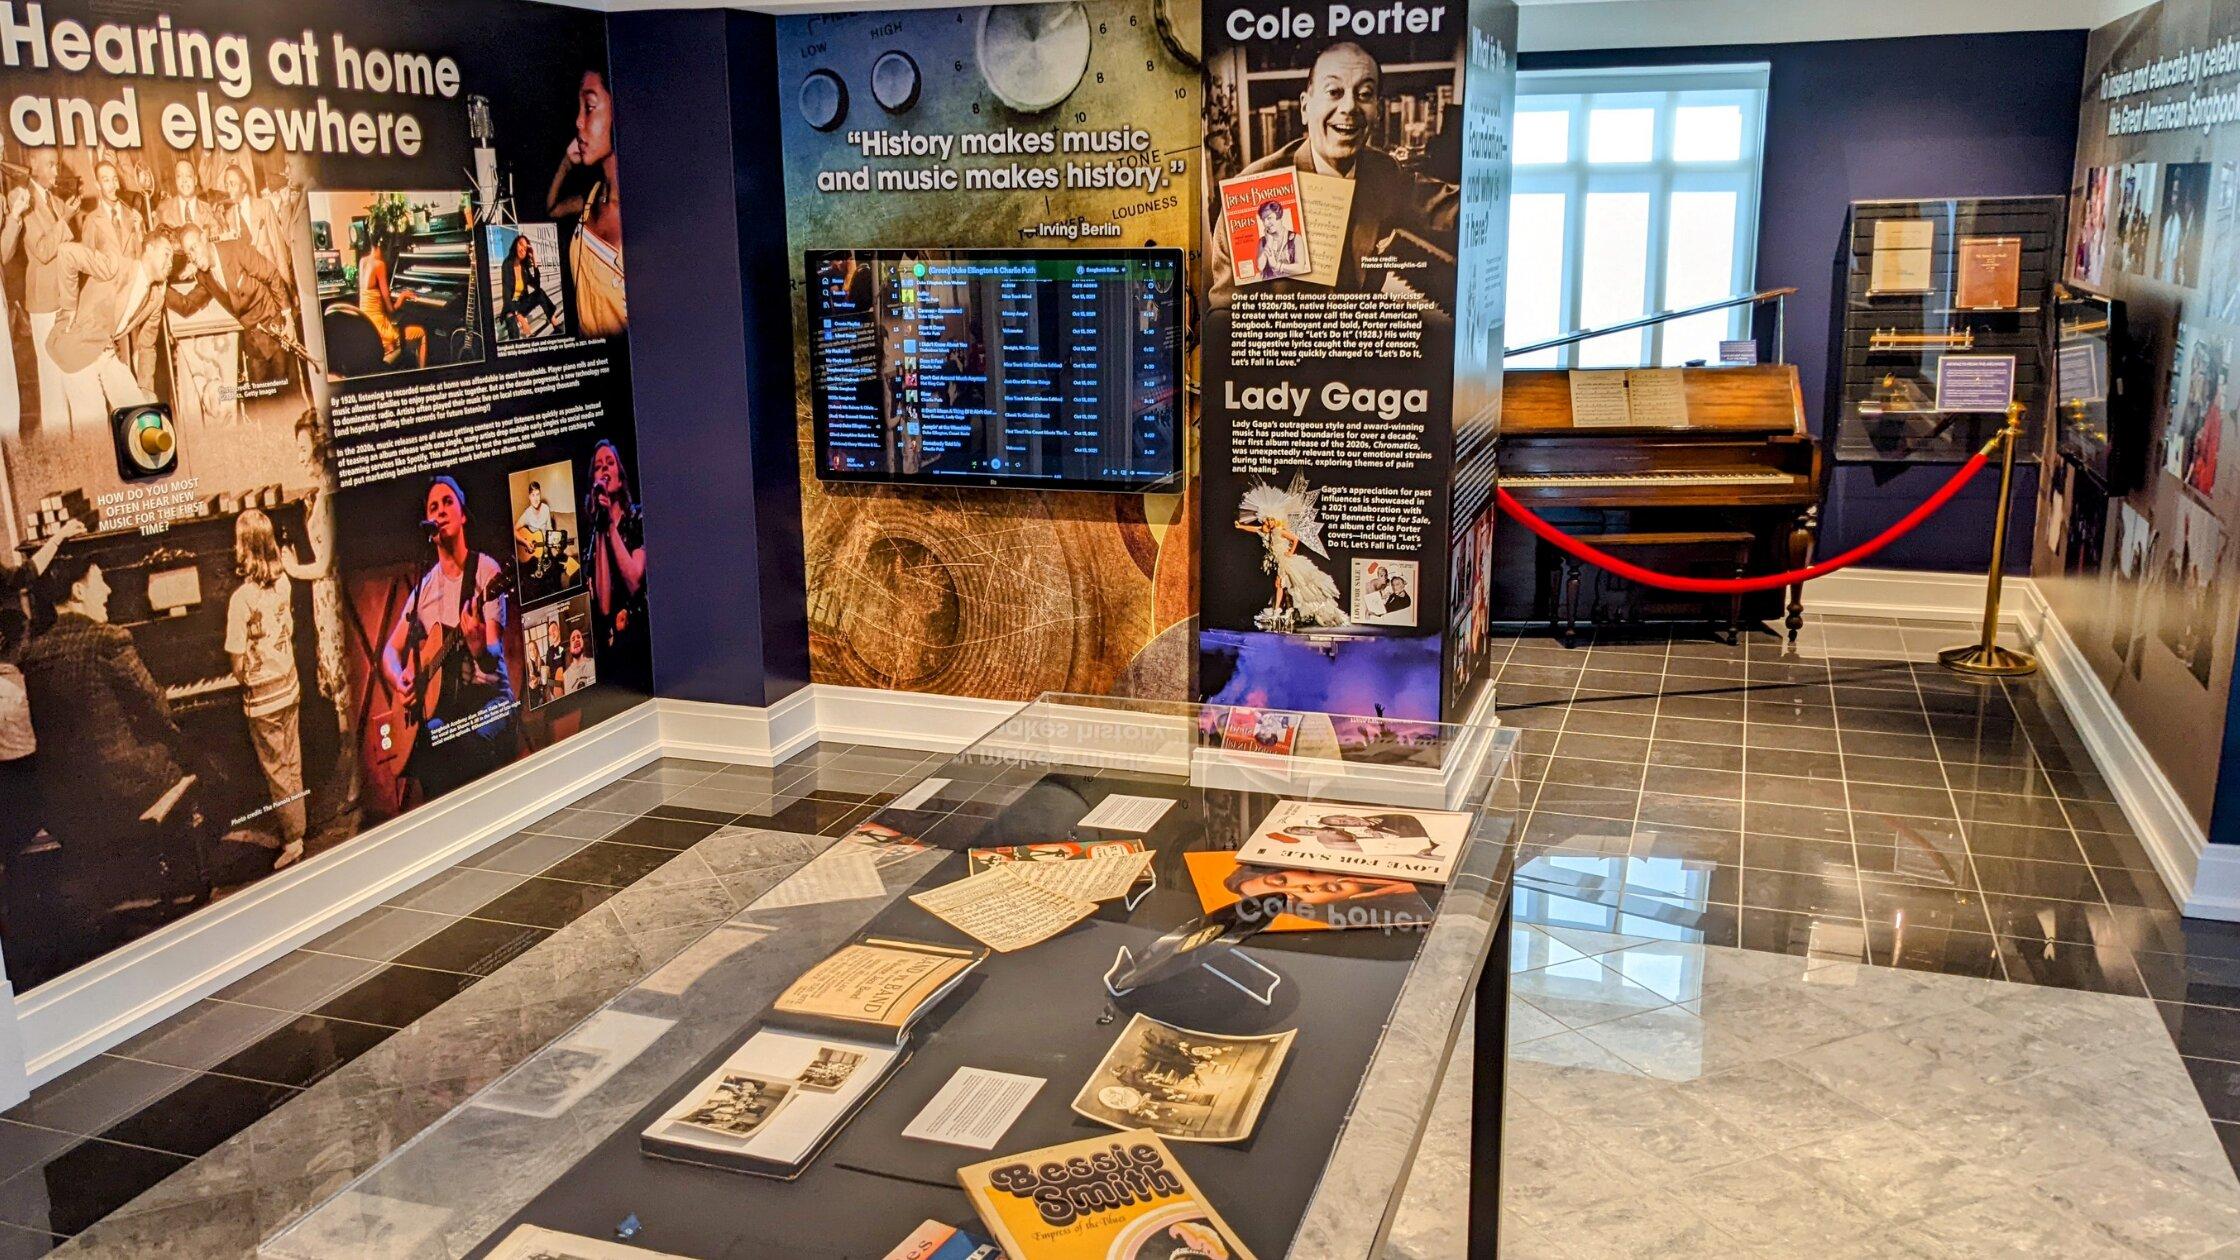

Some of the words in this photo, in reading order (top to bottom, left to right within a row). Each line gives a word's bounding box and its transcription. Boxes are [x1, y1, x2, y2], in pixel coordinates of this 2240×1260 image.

[956, 14, 963, 24] 4
[1130, 16, 1137, 27] 6
[1226, 8, 1315, 41] Cole
[1328, 1, 1445, 37] Porter
[870, 21, 903, 39] HIGH
[1100, 24, 1107, 34] 6
[0, 1, 253, 98] Hearing
[269, 29, 319, 87] at
[333, 32, 461, 97] home
[801, 41, 827, 58] LOW
[954, 61, 962, 72] 6
[1146, 60, 1154, 71] 8
[2132, 60, 2149, 95] and
[2149, 50, 2188, 90] educate
[2188, 46, 2202, 88] by
[1097, 73, 1104, 84] 8
[1175, 88, 1186, 99] 10
[972, 103, 980, 114] 8
[9, 86, 141, 149] and
[160, 89, 422, 156] elsewhere
[1075, 112, 1087, 124] 10
[2108, 108, 2120, 136] the
[2120, 102, 2144, 135] Great
[2142, 97, 2187, 132] American
[847, 130, 953, 161] “History
[960, 127, 1055, 154] makes
[1062, 125, 1149, 152] music
[1116, 149, 1161, 168] TONE
[817, 165, 870, 191] and
[877, 165, 958, 191] music
[965, 163, 1059, 190] makes
[1067, 160, 1186, 192] history.”
[1112, 195, 1178, 220] LOUDNESS
[1039, 223, 1078, 239] Irving
[1082, 223, 1121, 236] Berlin
[1230, 218, 1256, 233] PARIS
[929, 266, 951, 275] (Green)
[967, 266, 993, 275] Ellington
[1000, 266, 1021, 274] Charlie
[1022, 266, 1036, 274] Puth
[1231, 293, 1248, 301] One
[1250, 292, 1258, 301] of
[1260, 292, 1273, 301] the
[1275, 293, 1295, 301] most
[1297, 292, 1326, 301] famous
[1328, 293, 1371, 302] composers
[1373, 292, 1388, 301] and
[1390, 292, 1421, 302] lyricists
[1231, 302, 1240, 310] of
[1242, 302, 1255, 310] the
[1257, 302, 1297, 311] 1920s/30s,
[1299, 302, 1324, 310] native
[1326, 302, 1357, 310] Hoosier
[1359, 302, 1377, 310] Cole
[1379, 302, 1405, 310] Porter
[1406, 302, 1435, 312] helped
[1231, 311, 1240, 319] to
[1242, 312, 1266, 320] create
[1268, 311, 1289, 320] what
[1323, 311, 1338, 320] call
[1339, 311, 1353, 320] the
[1355, 311, 1377, 320] Great
[1379, 311, 1418, 320] American
[330, 397, 340, 408] By
[1224, 380, 1311, 416] Lady
[1321, 381, 1428, 421] Gaga
[1232, 420, 1250, 429] Lady
[1252, 420, 1277, 429] Gaga’s
[1279, 421, 1323, 430] outrageous
[1325, 421, 1344, 431] style
[1346, 422, 1361, 430] and
[1363, 423, 1424, 433] award-winning
[1232, 429, 1254, 437] music
[1255, 430, 1269, 438] has
[1271, 430, 1299, 439] pushed
[1301, 430, 1344, 439] boundaries
[1346, 431, 1359, 439] for
[1360, 432, 1378, 440] over
[1387, 432, 1418, 440] decade.
[1232, 438, 1247, 446] Her
[1248, 438, 1264, 446] first
[1265, 439, 1289, 447] album
[1291, 439, 1319, 447] release
[1320, 440, 1330, 448] of
[1331, 440, 1344, 448] the
[1346, 440, 1371, 449] 2020s,
[1373, 441, 1421, 450] Chromatica,
[97, 492, 124, 506] HOW
[127, 488, 143, 500] DO
[146, 484, 168, 496] YOU
[171, 478, 199, 491] MOST
[106, 503, 140, 517] OFTEN
[142, 496, 170, 510] HEAR
[172, 491, 194, 504] NEW
[98, 516, 133, 532] MUSIC
[135, 512, 155, 524] FOR
[157, 507, 177, 519] THE
[179, 501, 204, 515] FIRST
[139, 521, 170, 537] TIME?
[1280, 850, 1332, 861] SALE
[1340, 856, 1379, 866] FOR
[1387, 861, 1440, 873] LOVE
[989, 1143, 1163, 1197] Bessie
[1033, 1165, 1185, 1226] Smith
[1033, 1227, 1072, 1241] Empress
[1074, 1222, 1084, 1235] of
[1086, 1219, 1099, 1230] the
[1101, 1214, 1126, 1227] Blues
